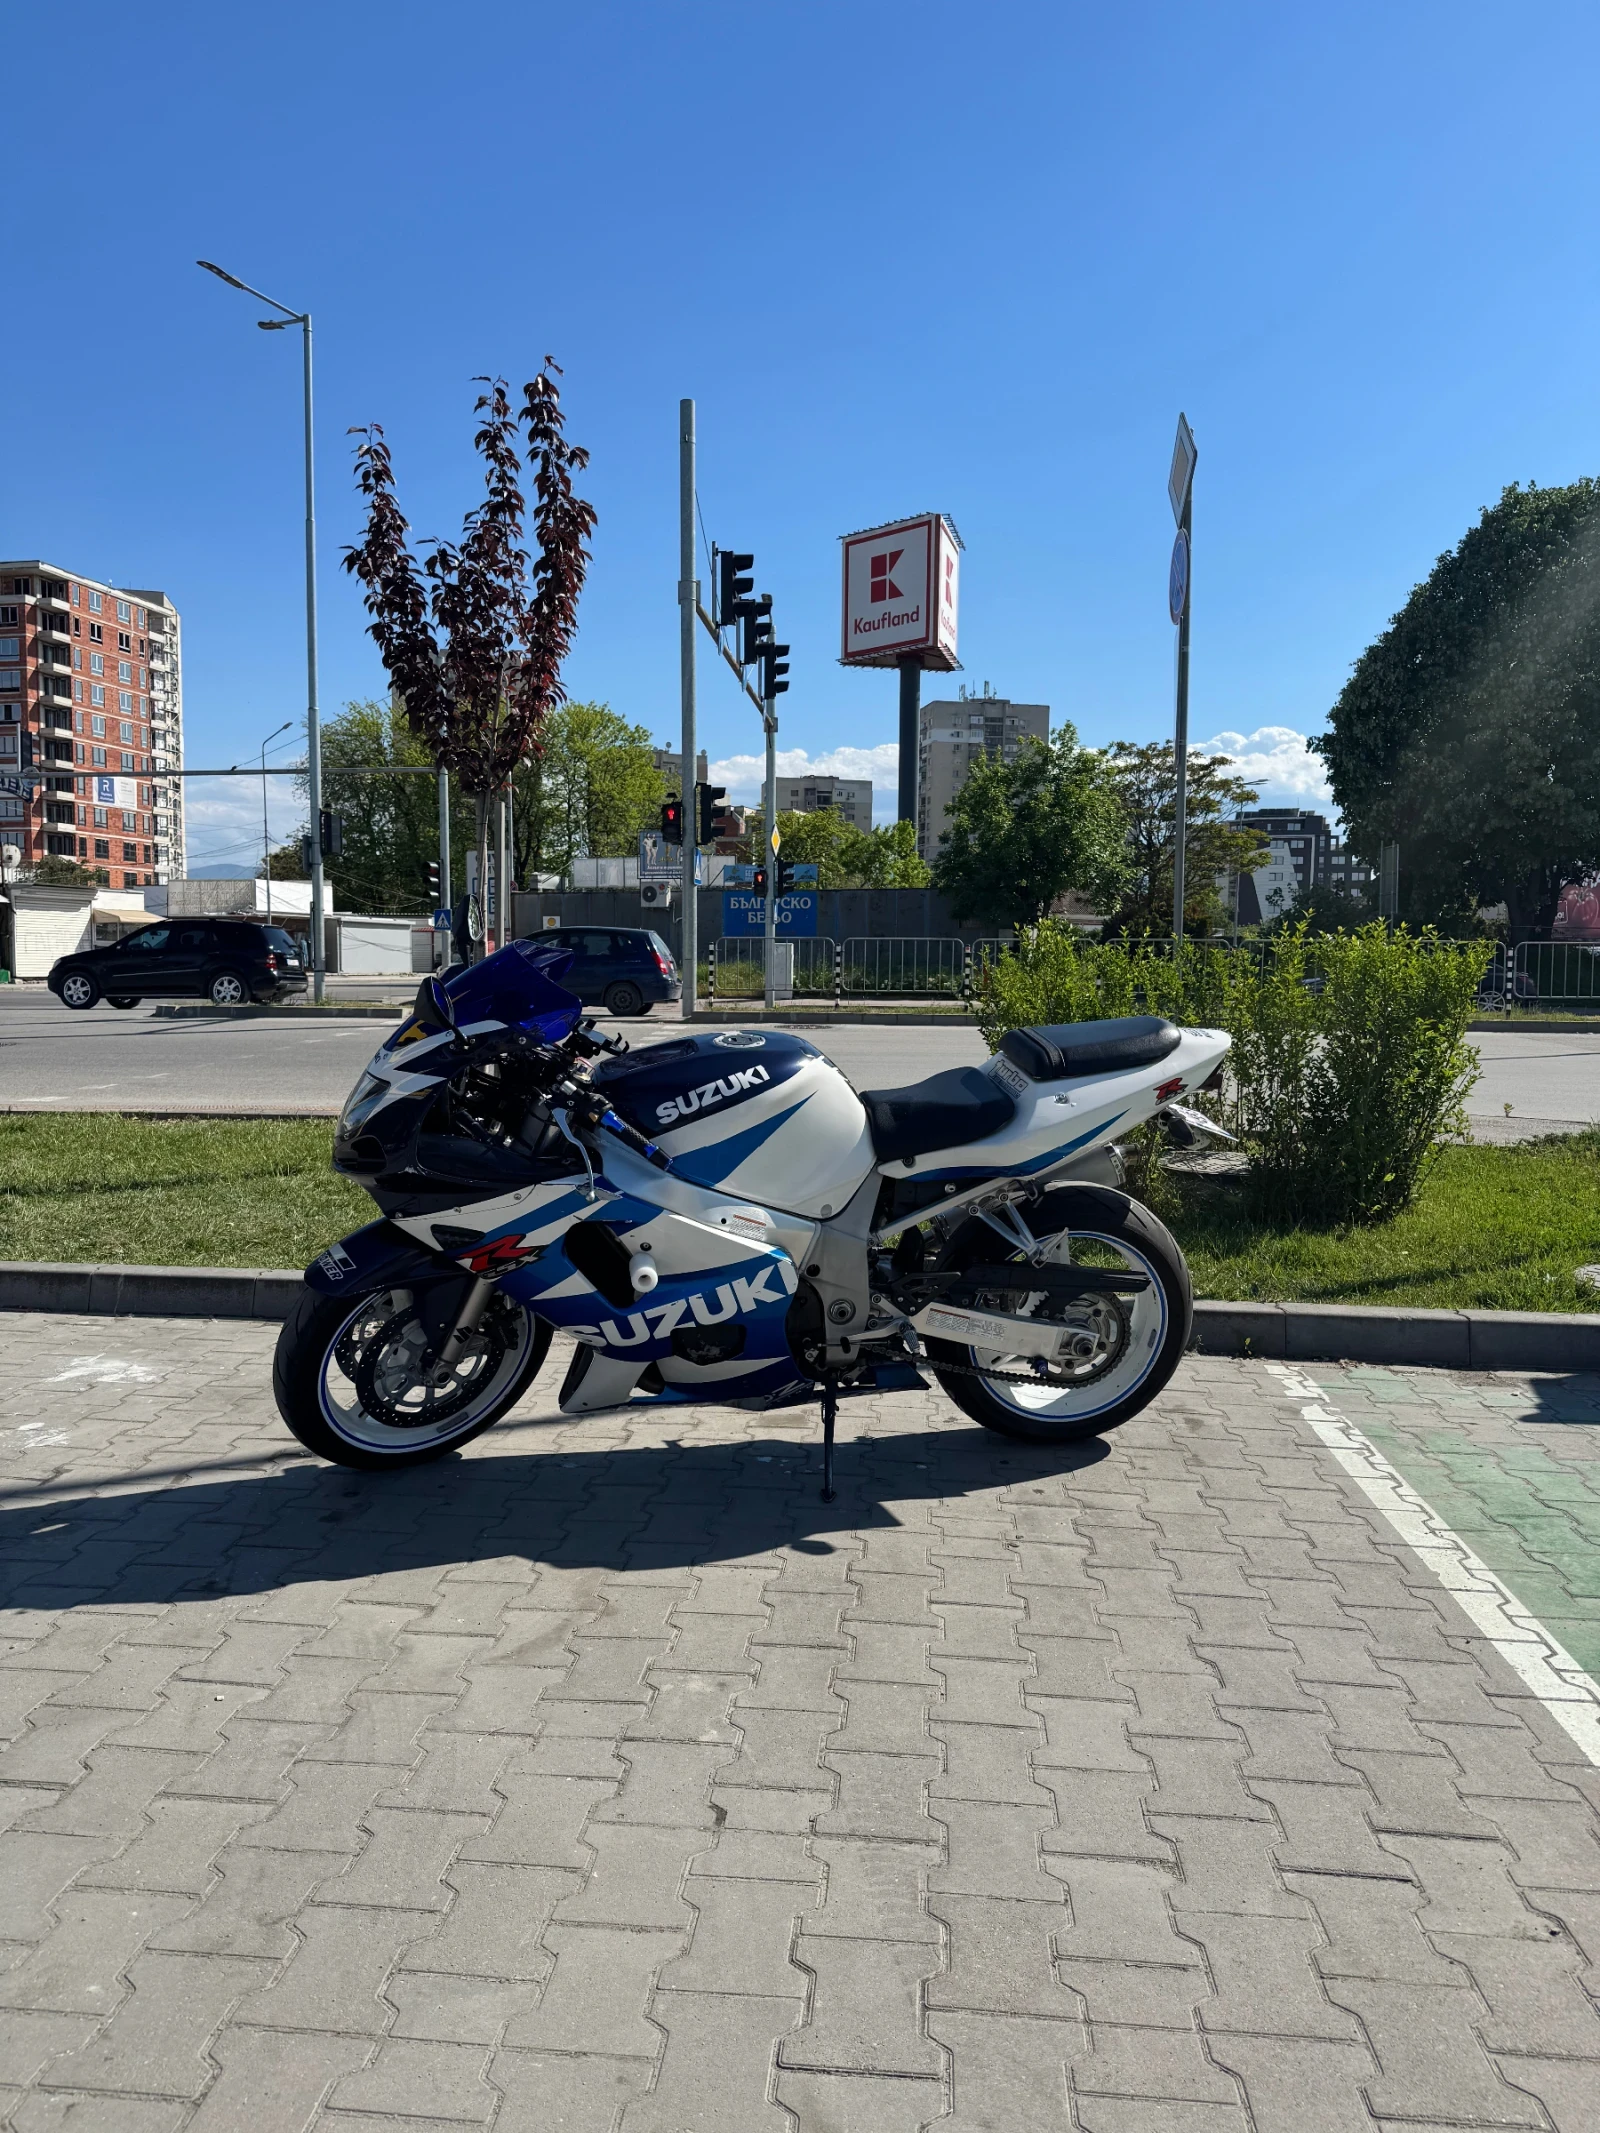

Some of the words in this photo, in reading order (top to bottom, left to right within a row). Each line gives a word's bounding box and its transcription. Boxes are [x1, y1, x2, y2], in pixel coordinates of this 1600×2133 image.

[854, 605, 920, 635] Kaufland
[730, 897, 812, 910] БЪЛГСКО
[656, 1064, 770, 1124] SUZUKI
[559, 1261, 799, 1348] SUZUKI
